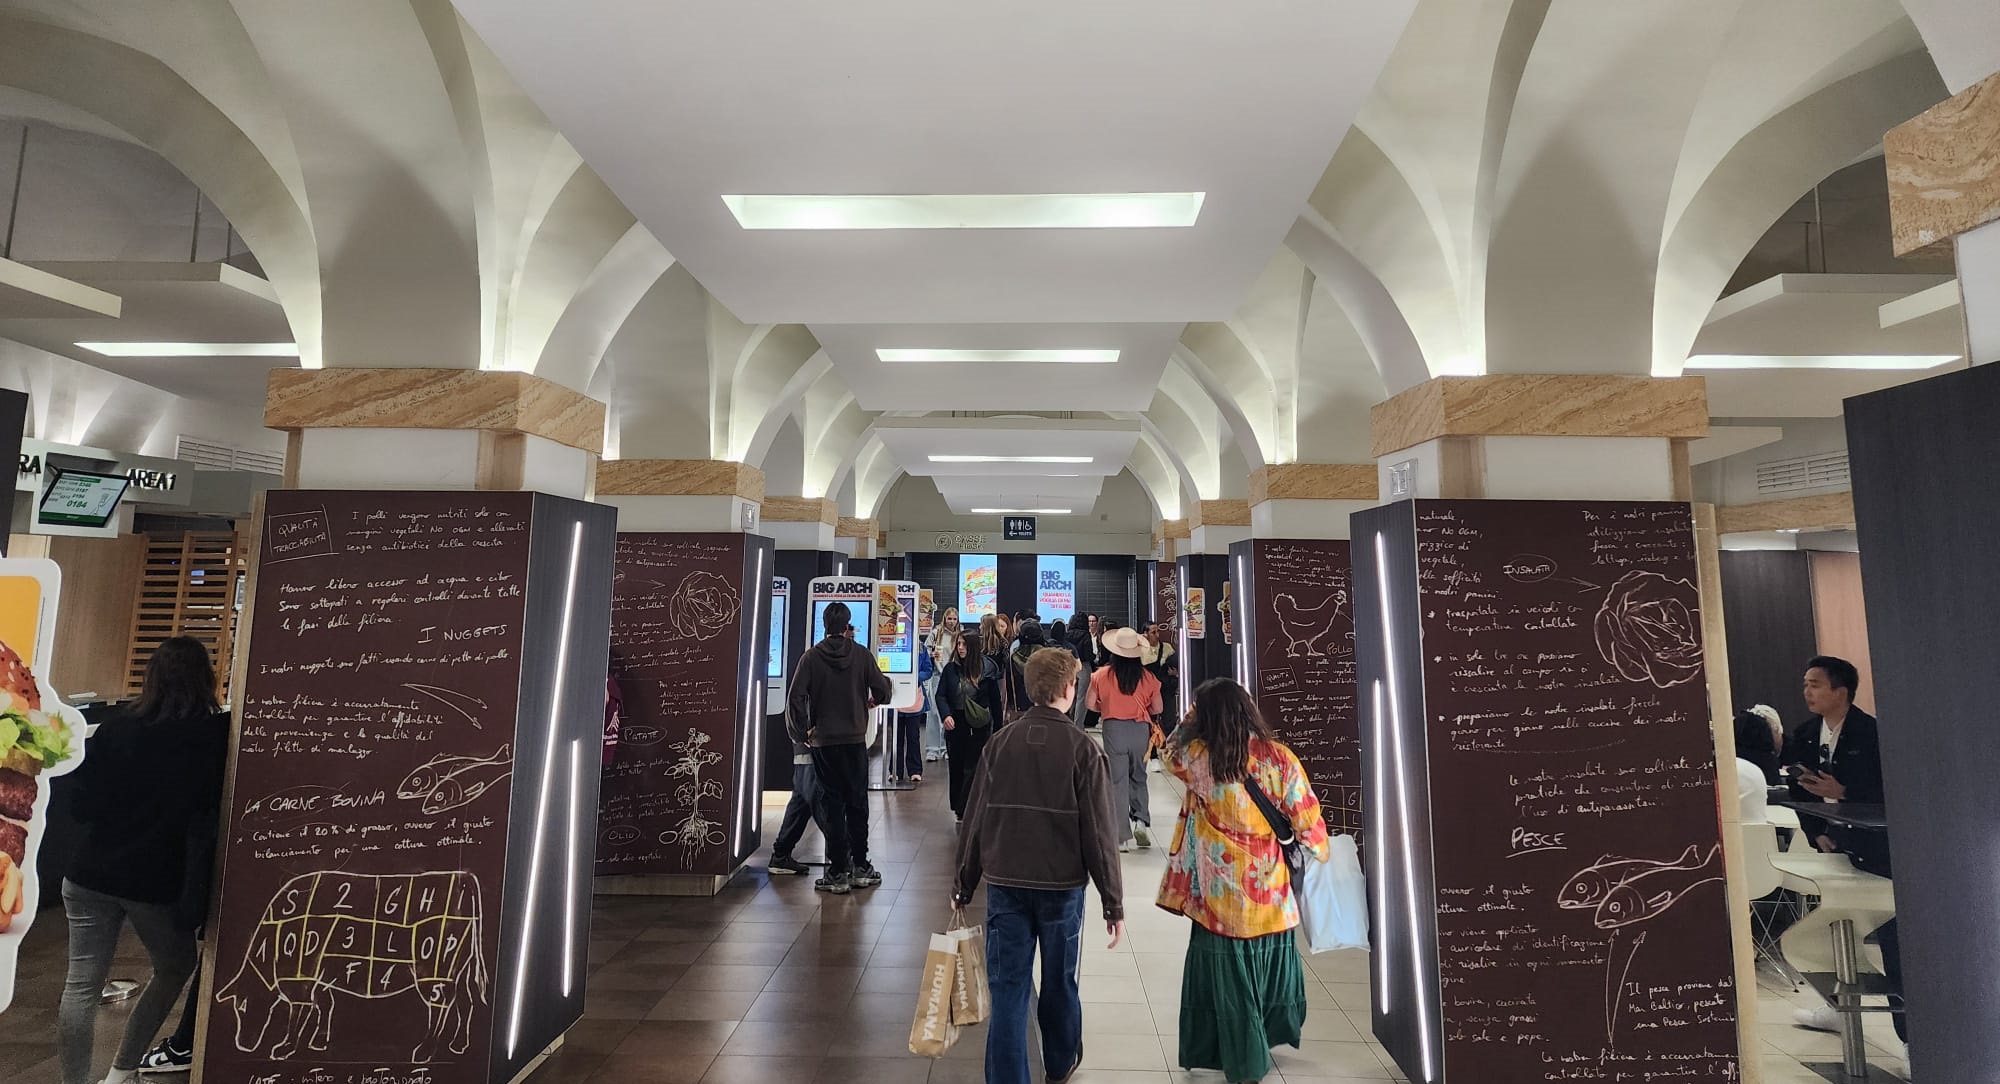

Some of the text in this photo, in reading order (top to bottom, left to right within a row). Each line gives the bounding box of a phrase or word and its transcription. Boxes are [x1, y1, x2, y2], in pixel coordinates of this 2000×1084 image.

[772, 581, 787, 589] CH
[1041, 571, 1060, 580] BIG
[813, 583, 872, 593] BIG ARCH
[1040, 581, 1071, 590] ARCH
[417, 624, 508, 643] I NUGGETS
[268, 795, 321, 811] CARNE
[331, 788, 385, 808] BOVINA
[1320, 788, 1332, 802] 2
[1327, 810, 1335, 822] 3
[608, 830, 636, 841] OLIO
[1511, 826, 1566, 850] PESCE
[333, 882, 353, 909] 2
[384, 887, 401, 914] G
[419, 889, 436, 913] H
[304, 930, 320, 956] D
[342, 926, 355, 949] 3
[387, 934, 398, 953] L
[345, 962, 392, 991] F 4
[956, 952, 969, 1011] HUMANA
[922, 963, 945, 1041] HUMANA
